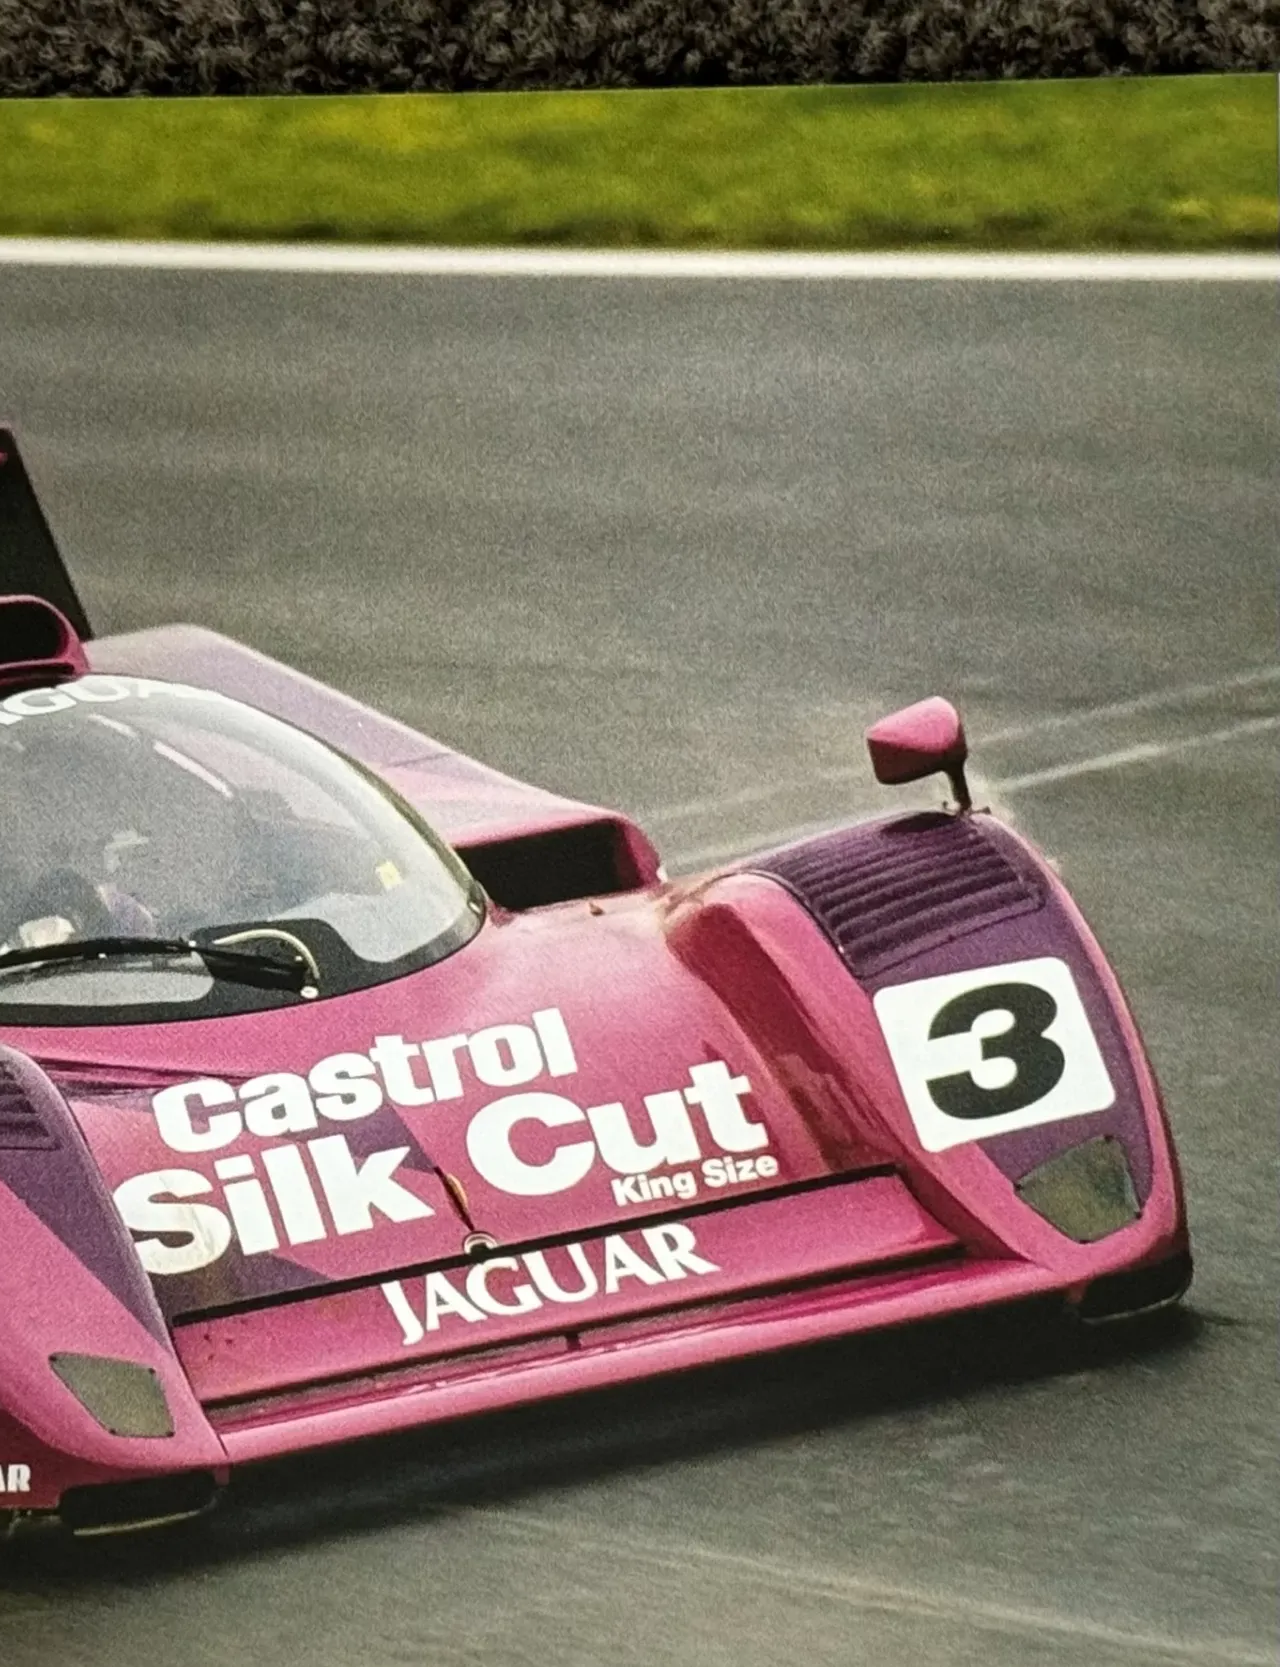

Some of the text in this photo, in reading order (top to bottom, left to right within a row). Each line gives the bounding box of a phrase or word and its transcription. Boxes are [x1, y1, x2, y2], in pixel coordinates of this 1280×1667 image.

[926, 982, 1066, 1120] 3
[113, 1059, 770, 1276] Silk Cut
[611, 1155, 779, 1207] King Size
[380, 1221, 720, 1347] JAGUAR
